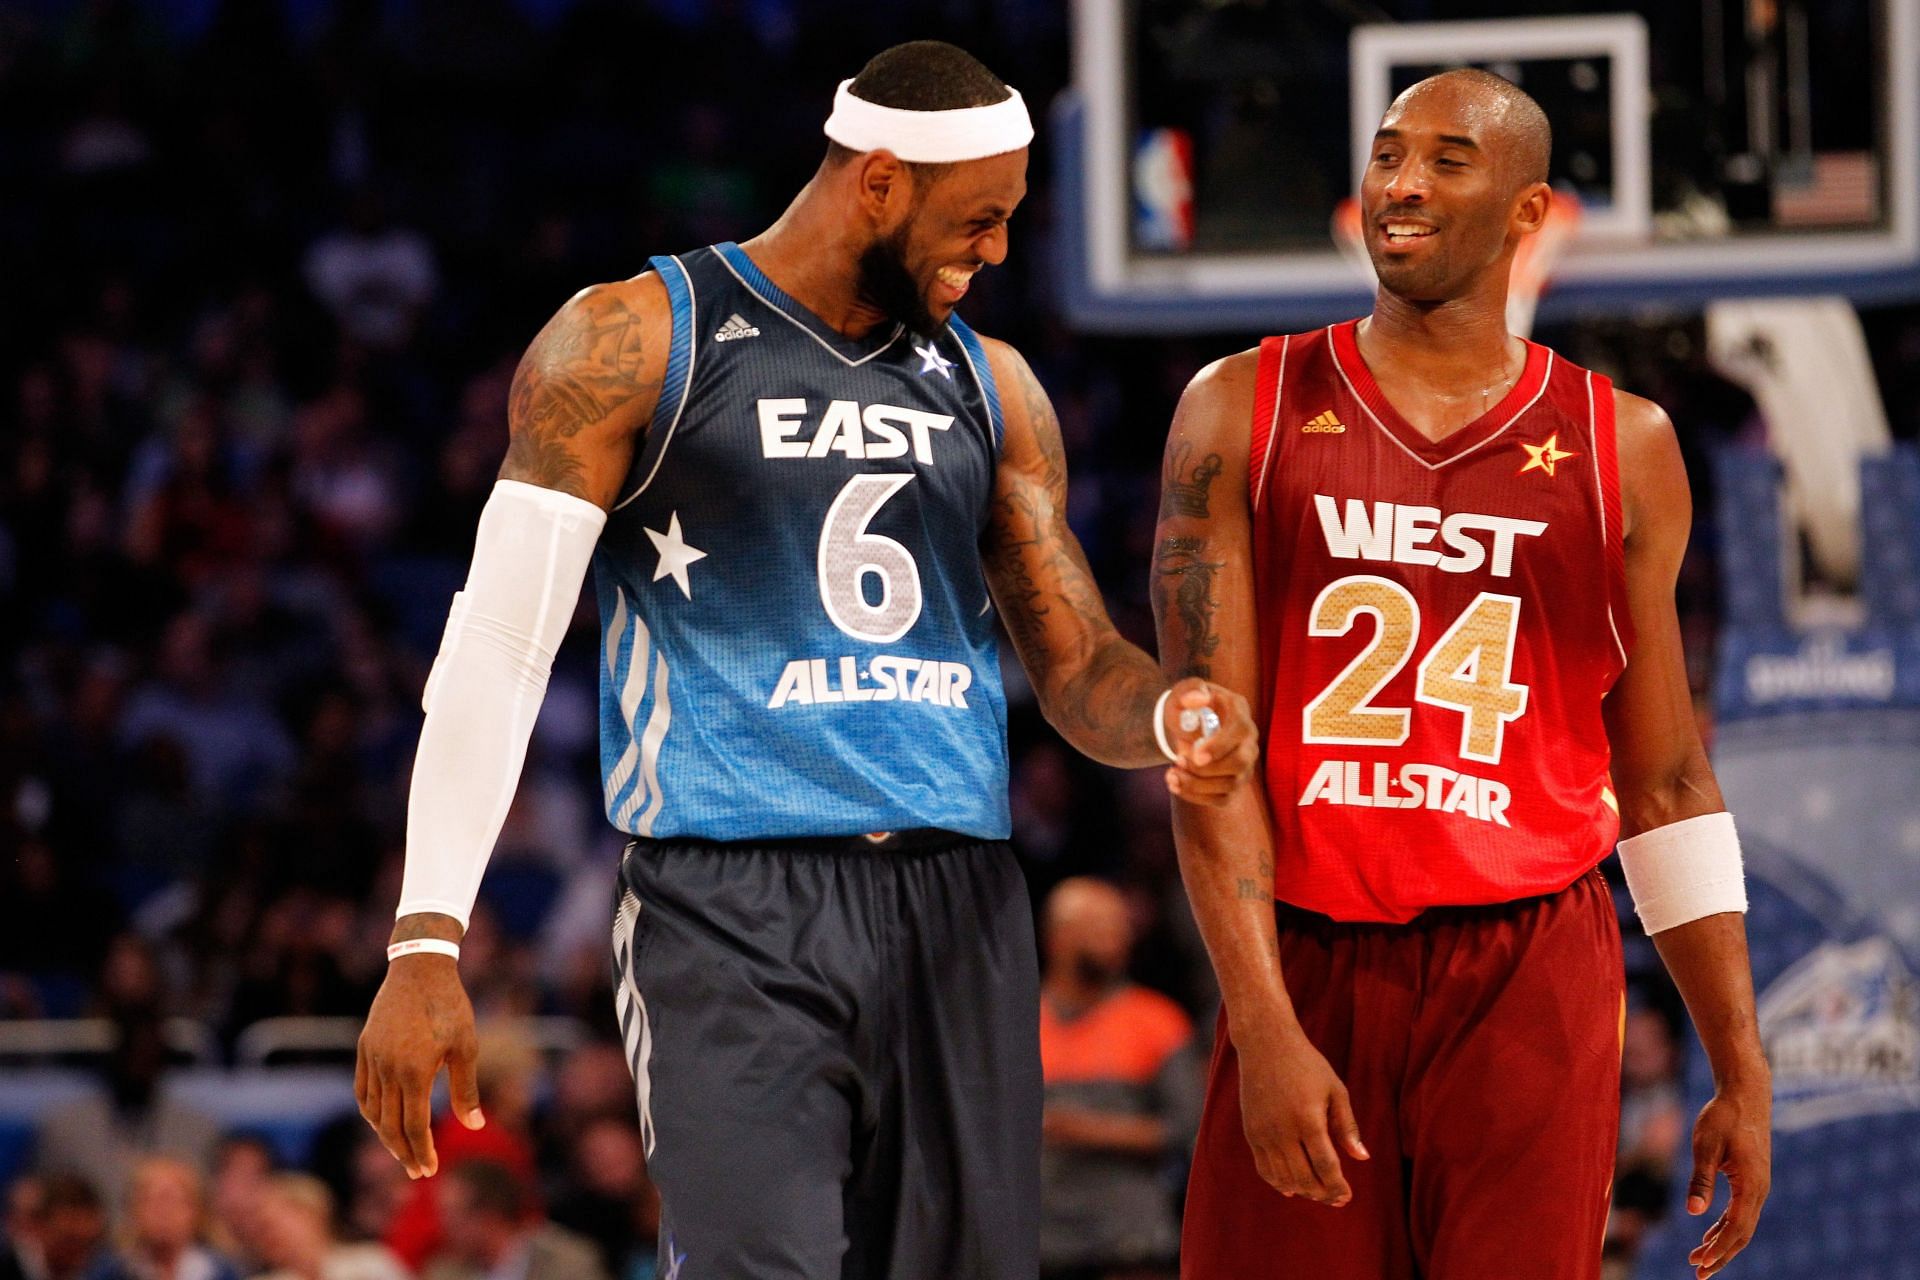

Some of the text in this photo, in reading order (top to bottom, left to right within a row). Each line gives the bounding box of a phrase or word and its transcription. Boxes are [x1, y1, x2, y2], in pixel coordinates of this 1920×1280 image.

[715, 326, 760, 343] adidas
[757, 398, 955, 466] EAST
[1301, 423, 1346, 434] adidas
[817, 473, 923, 643] 6
[1313, 494, 1550, 578] WEST
[1302, 574, 1530, 765] 24
